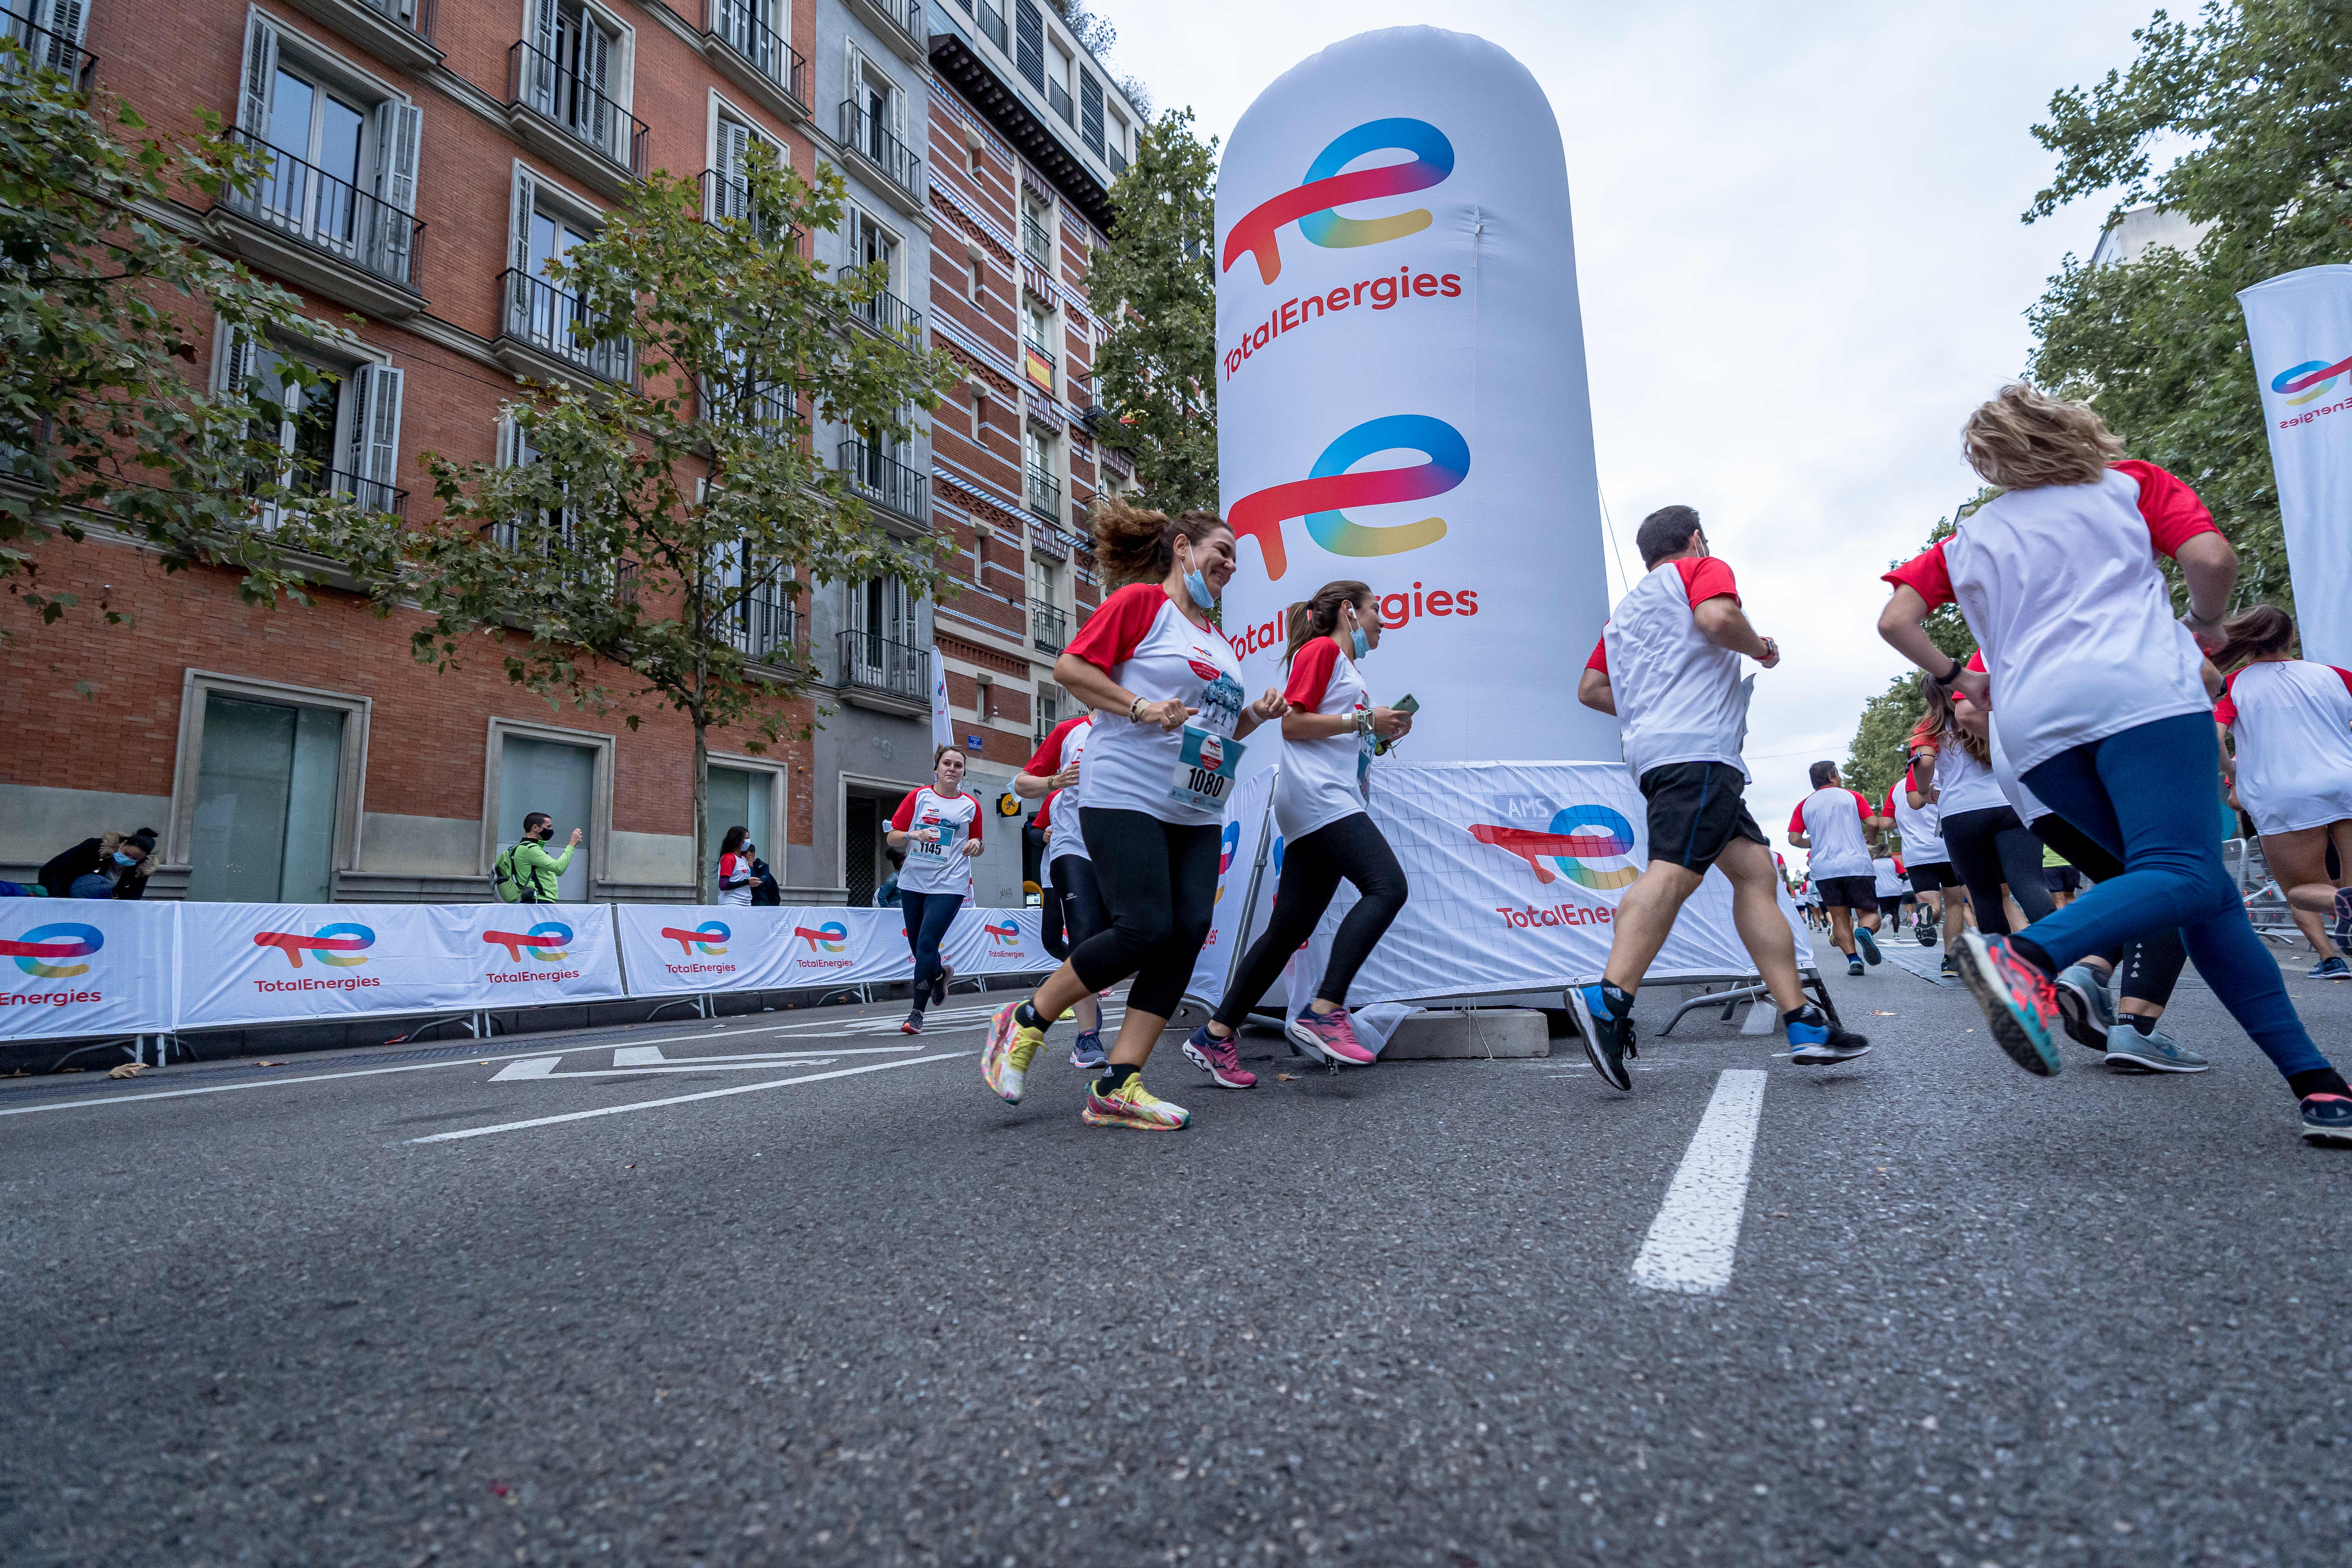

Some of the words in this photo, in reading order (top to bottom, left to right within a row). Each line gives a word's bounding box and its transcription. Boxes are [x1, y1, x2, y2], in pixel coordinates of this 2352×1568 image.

[1223, 266, 1461, 383] TotalEnergies
[1229, 581, 1479, 662] Totalgies
[1188, 767, 1224, 797] 1080
[1508, 798, 1549, 817] AMS
[920, 842, 942, 855] 1145
[1495, 904, 1618, 929] TotalEne
[666, 963, 736, 974] TotalEnergies
[797, 959, 853, 969] TotalEnergies
[254, 975, 380, 993] TotalEnergies
[486, 969, 579, 984] TotalEnergies
